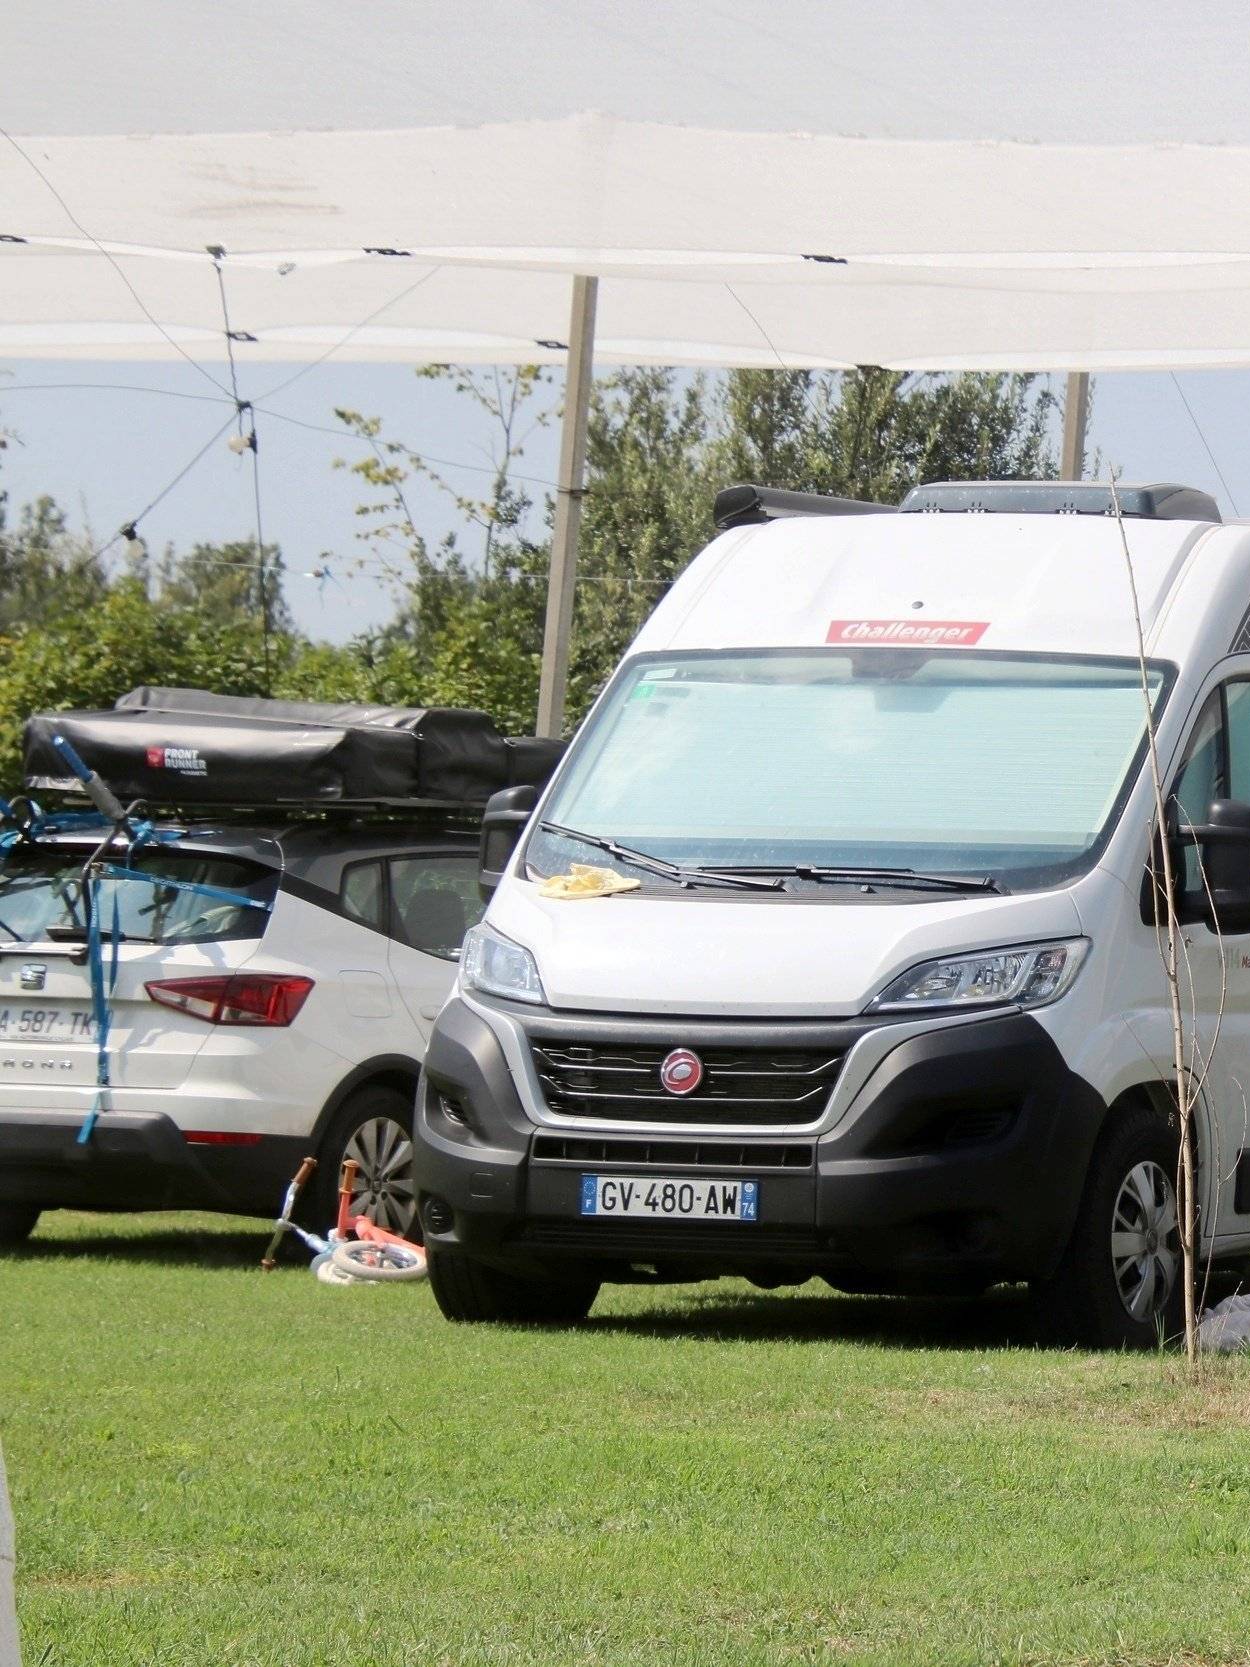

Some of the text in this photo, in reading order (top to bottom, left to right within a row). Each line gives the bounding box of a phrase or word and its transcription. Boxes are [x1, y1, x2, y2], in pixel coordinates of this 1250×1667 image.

[840, 621, 974, 643] Challenger
[164, 748, 199, 759] FRONT
[164, 759, 207, 770] RUNNER
[585, 1199, 592, 1209] F
[601, 1181, 738, 1215] GV-480-AW
[742, 1202, 755, 1217] 74
